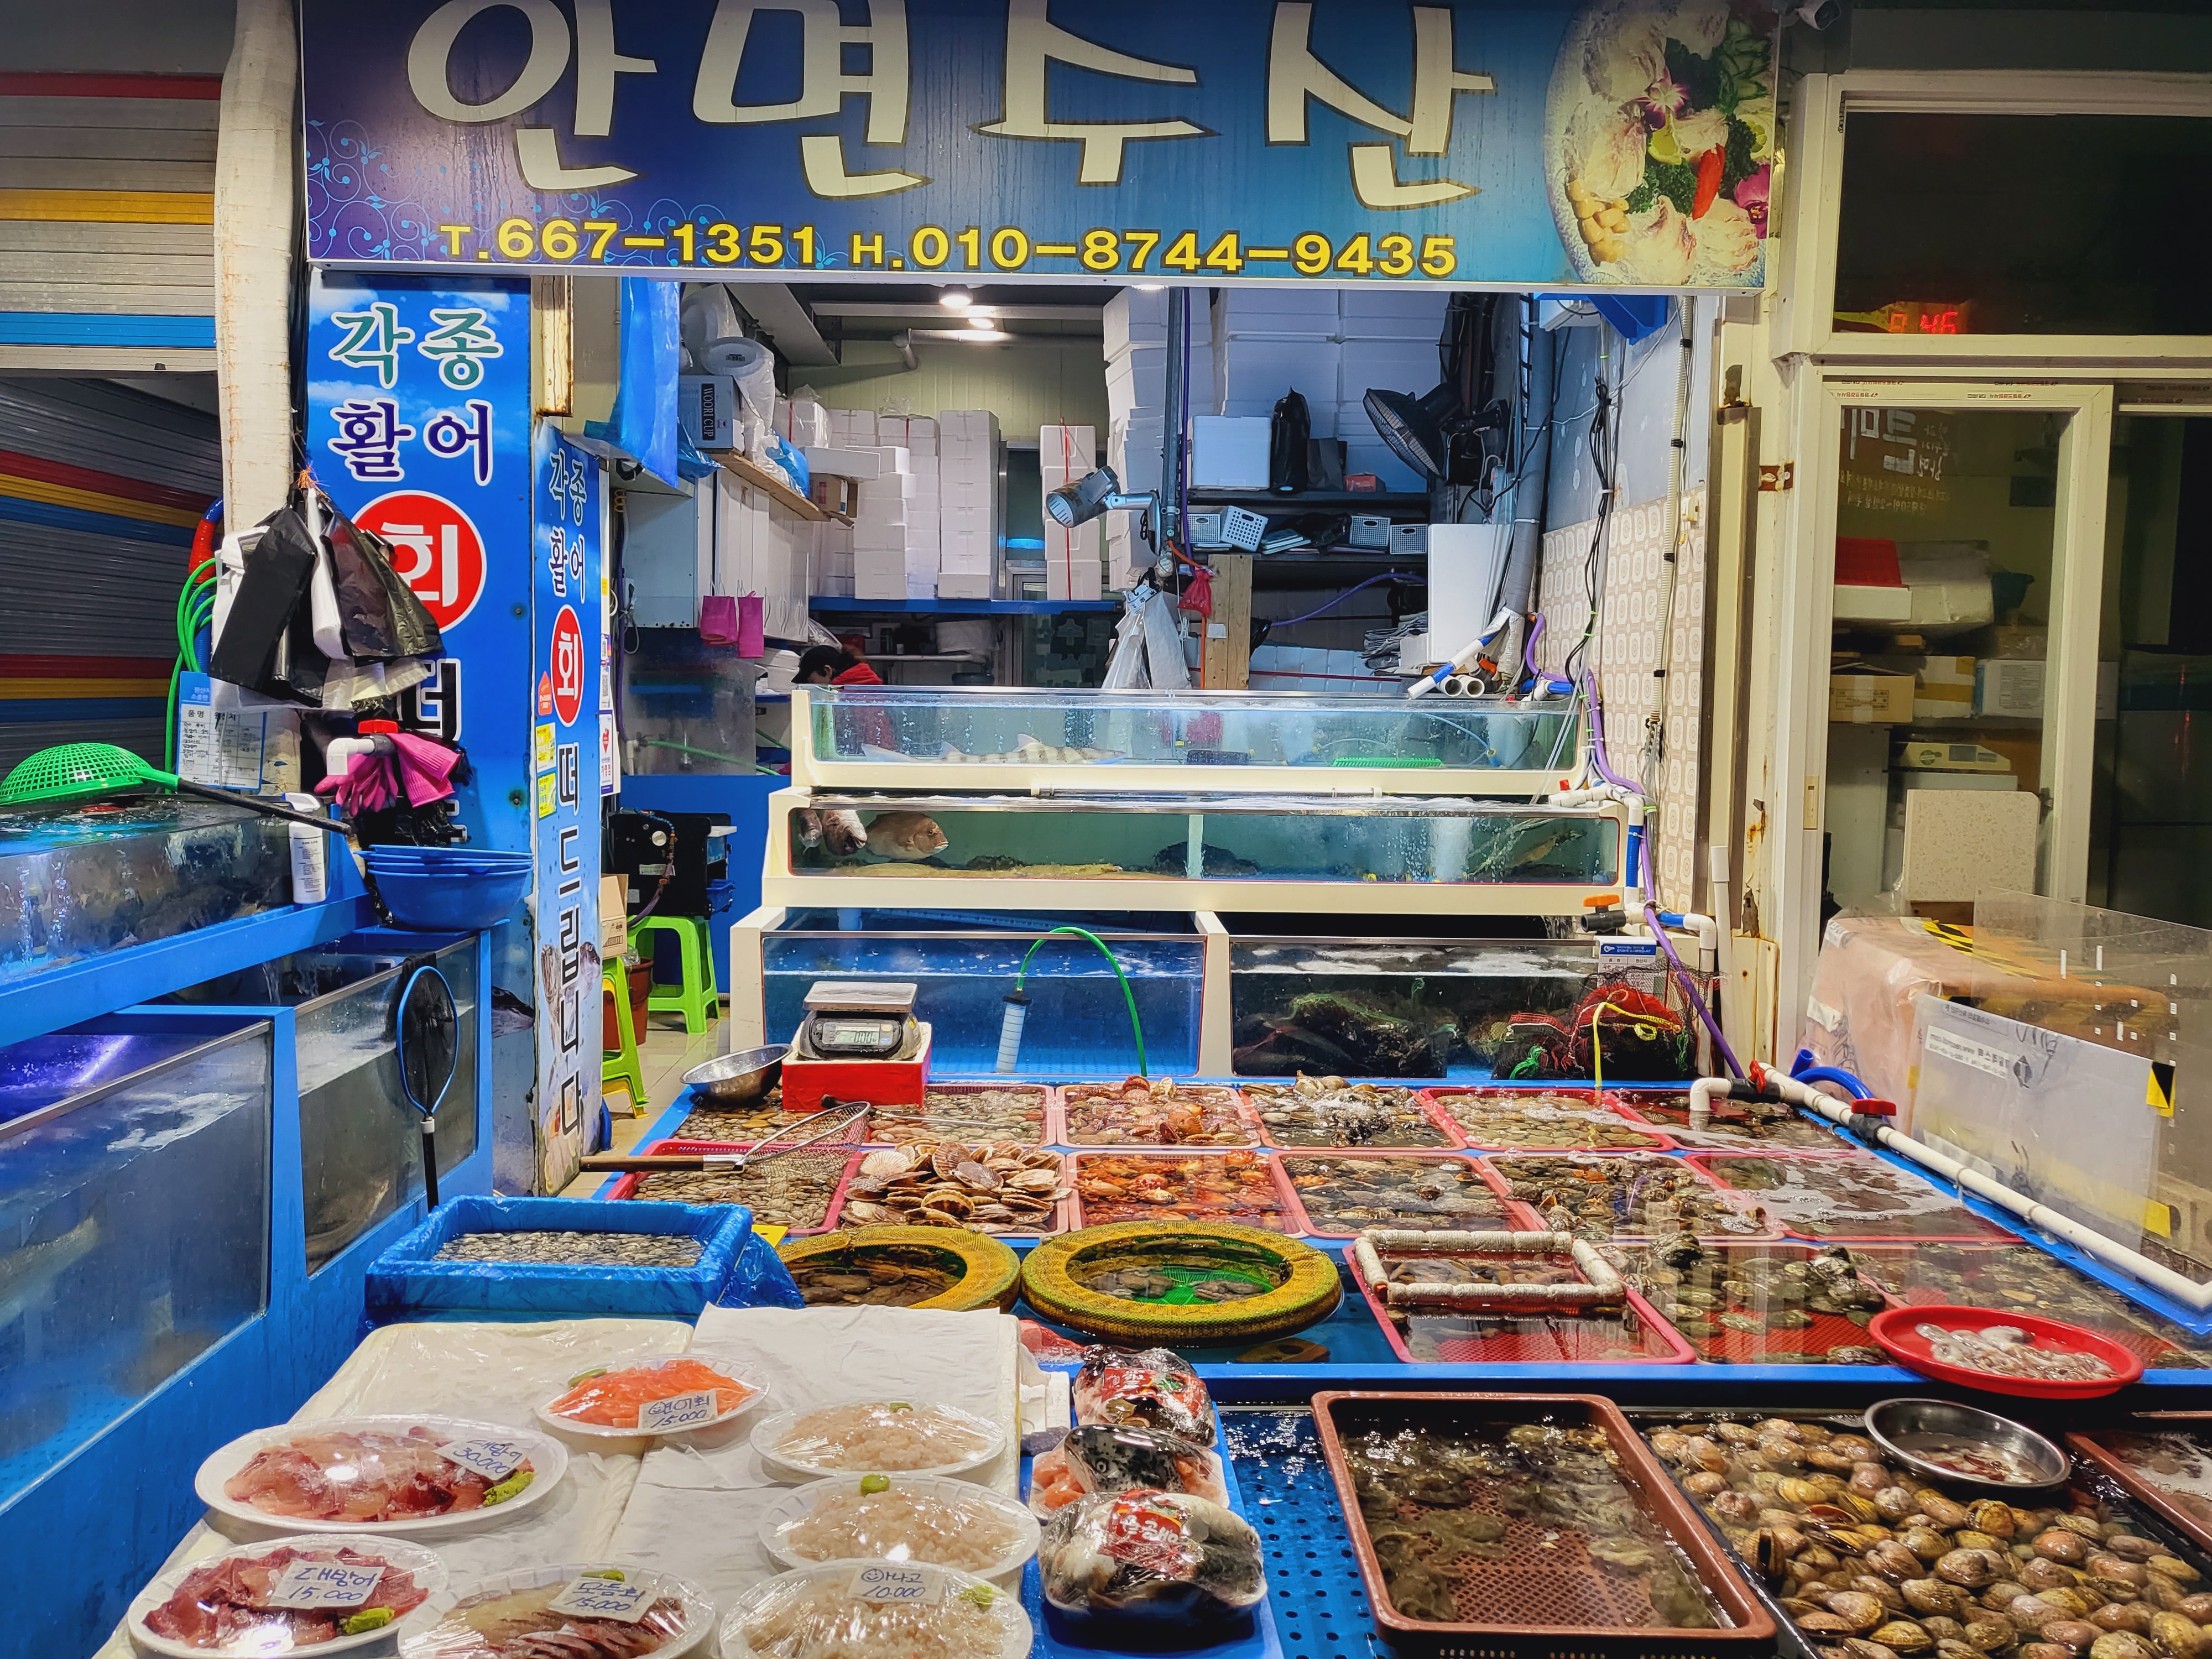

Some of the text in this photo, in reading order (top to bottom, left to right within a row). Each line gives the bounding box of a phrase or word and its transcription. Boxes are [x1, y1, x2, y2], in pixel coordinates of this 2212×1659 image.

[406, 0, 1495, 208] 안면수산
[440, 217, 1458, 277] T.667-1351 H.010-8744-9435
[329, 302, 504, 389] 각종
[328, 397, 493, 486] 활어
[703, 388, 714, 437] WOORI CUP
[549, 448, 586, 526] 각종
[380, 521, 459, 608] 회
[549, 525, 586, 604] 활어
[557, 630, 579, 701] 회
